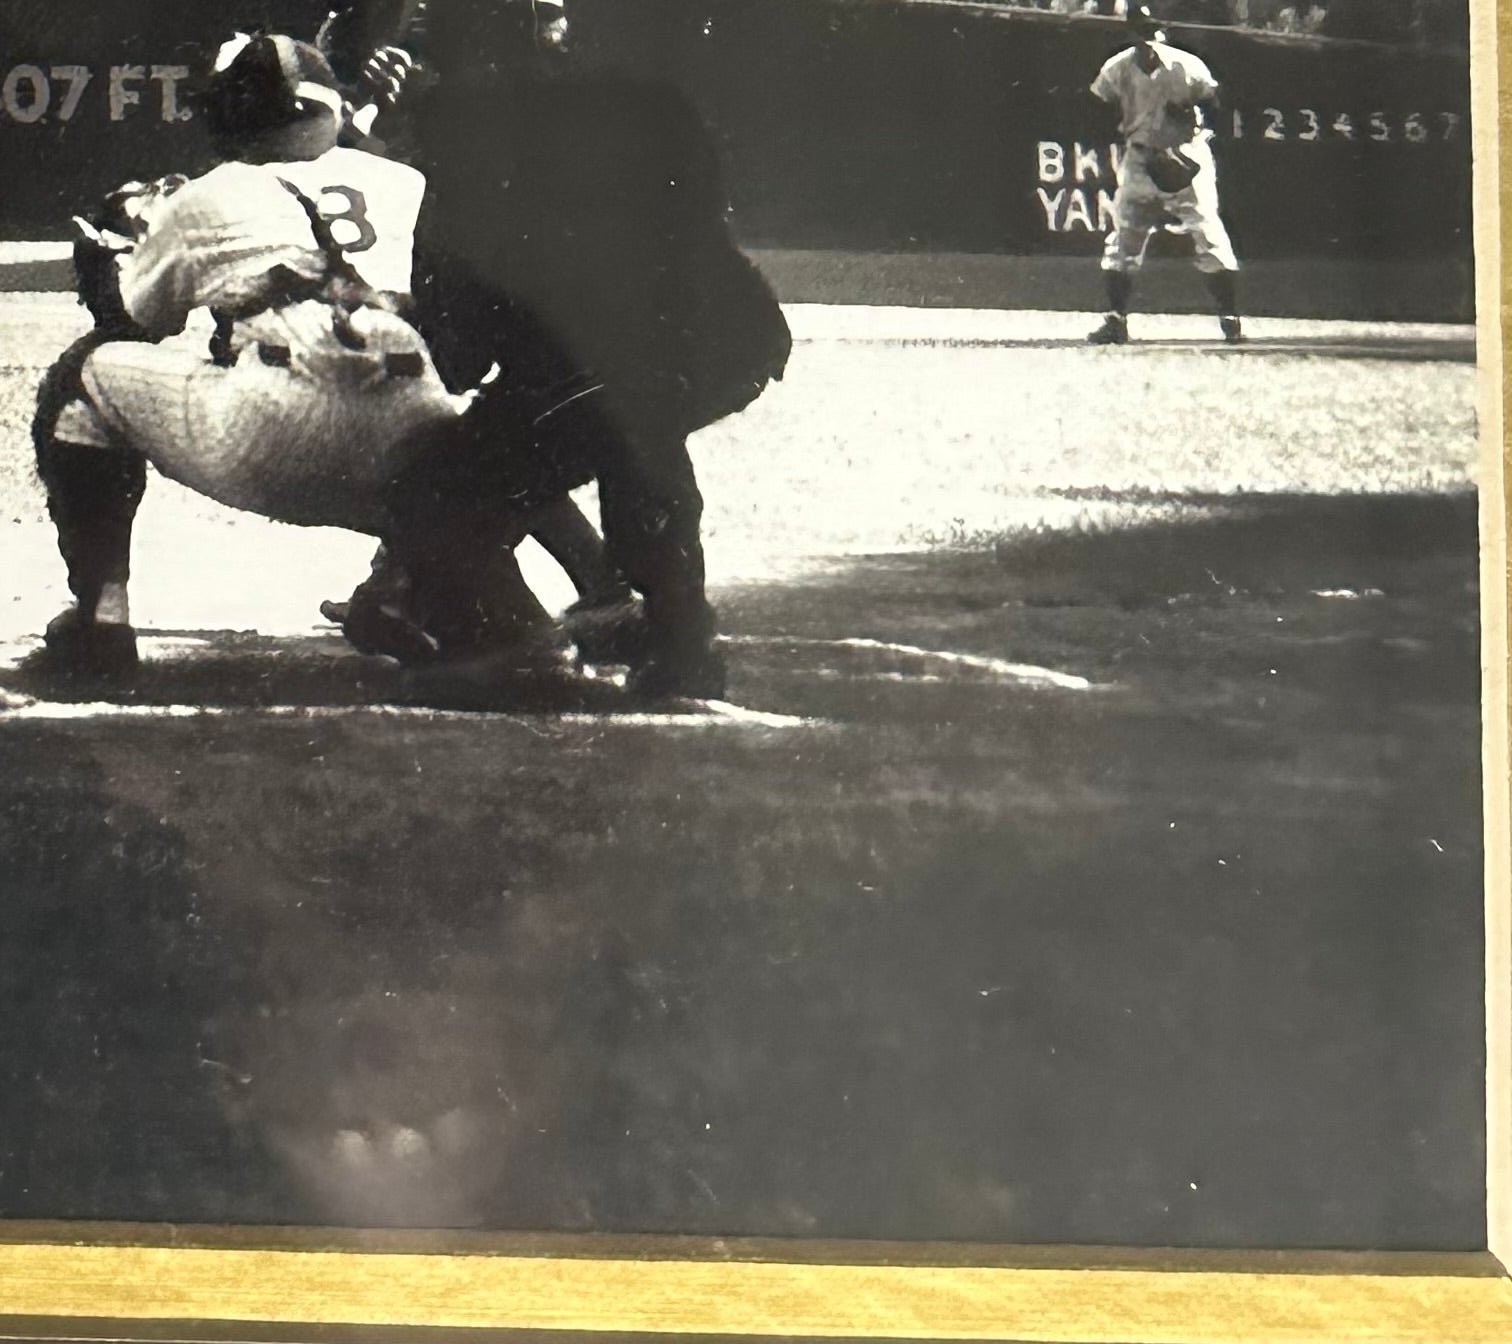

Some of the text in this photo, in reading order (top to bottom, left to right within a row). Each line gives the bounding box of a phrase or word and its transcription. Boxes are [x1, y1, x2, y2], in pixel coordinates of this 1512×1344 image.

[1233, 110, 1243, 139] 1
[1263, 108, 1286, 140] 2
[1299, 108, 1319, 140] 3
[1370, 111, 1391, 141] 5
[1405, 111, 1427, 143] 6
